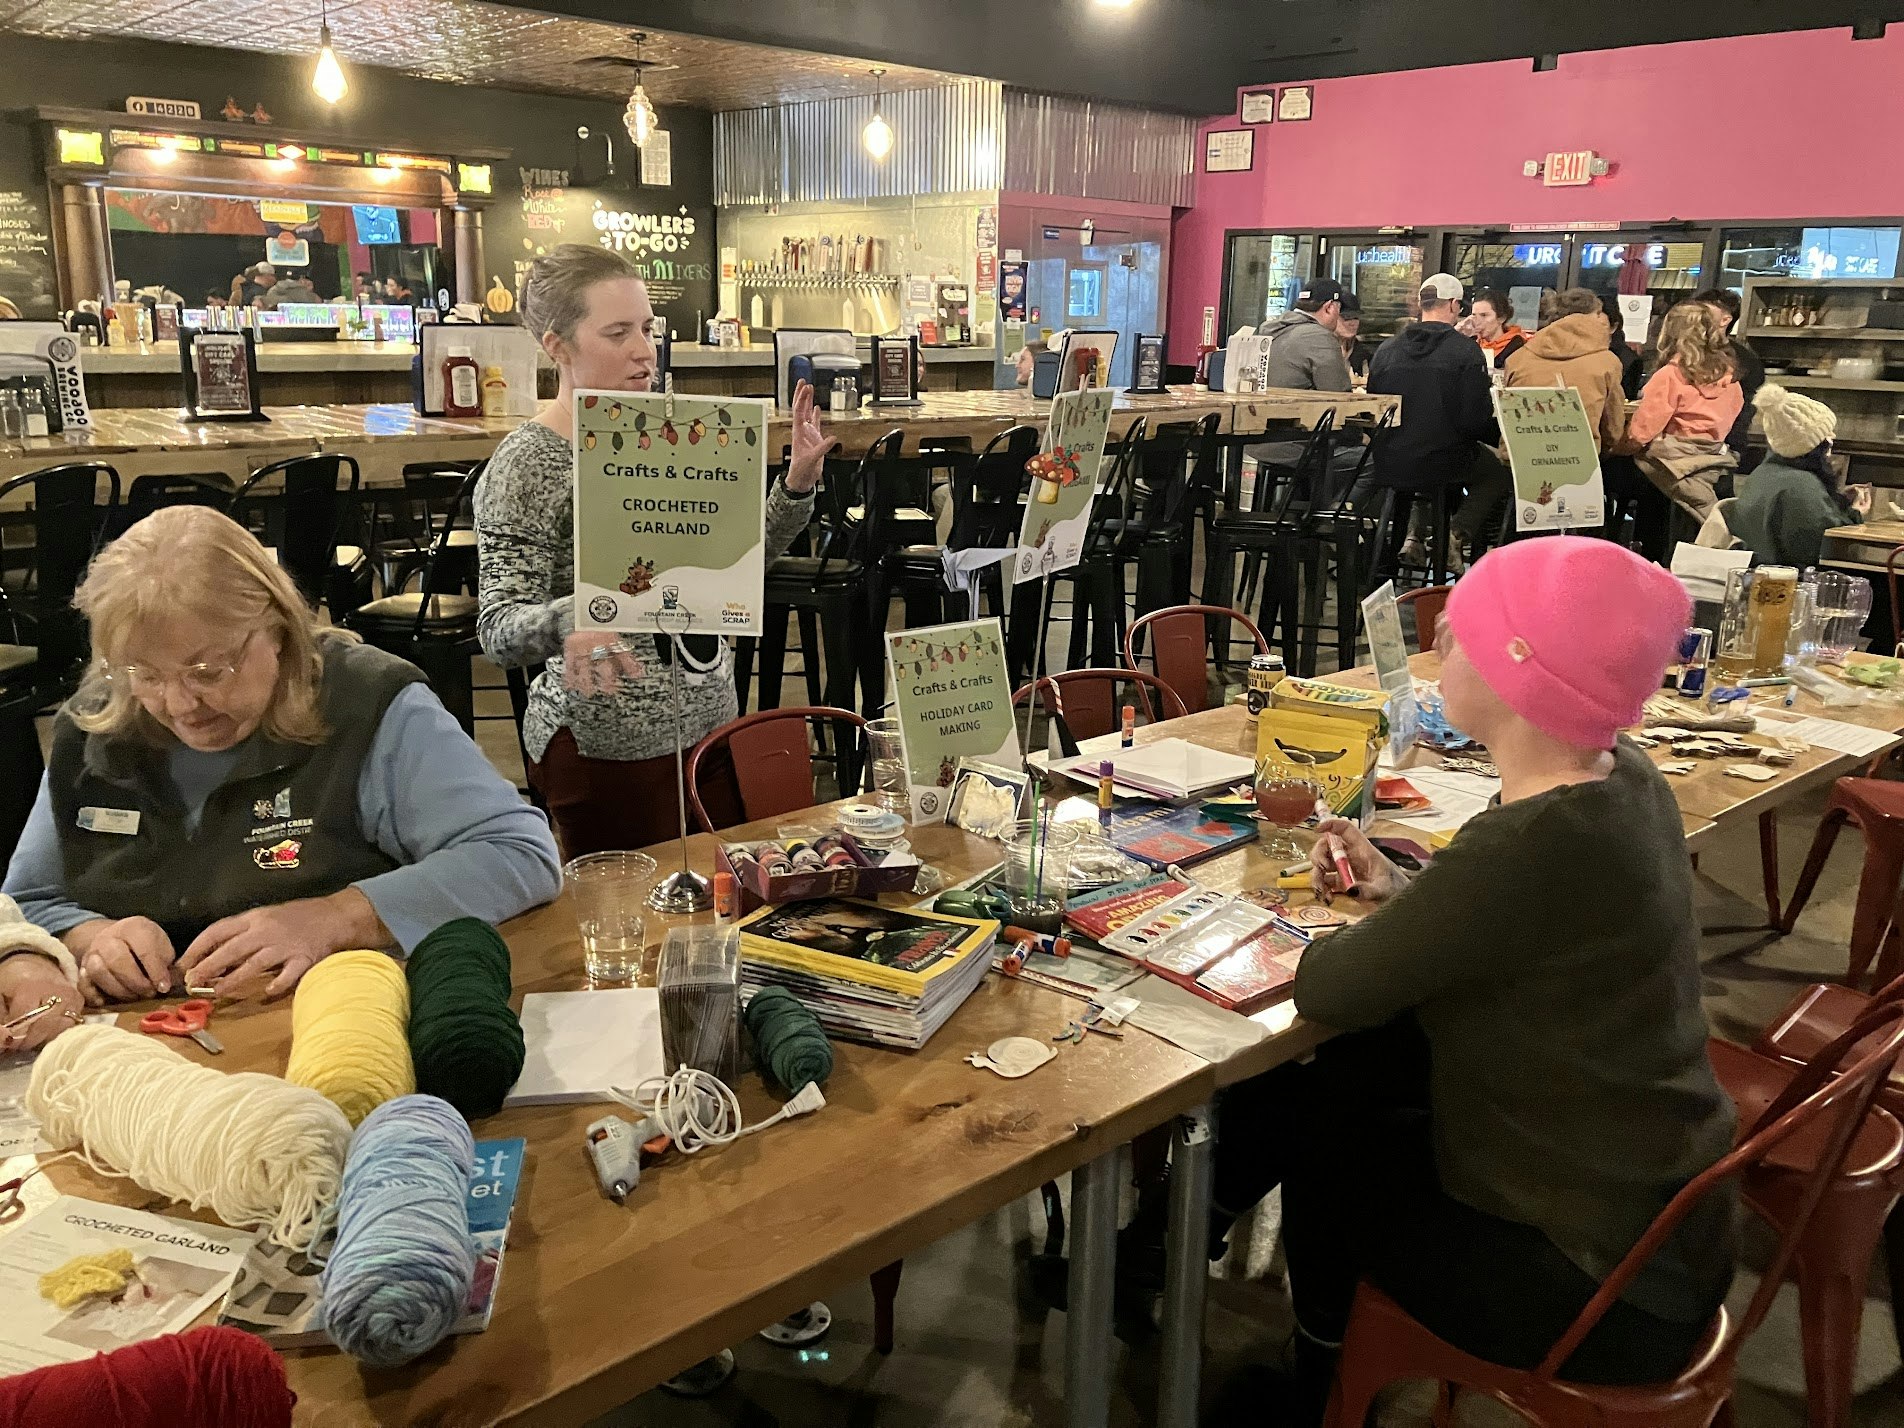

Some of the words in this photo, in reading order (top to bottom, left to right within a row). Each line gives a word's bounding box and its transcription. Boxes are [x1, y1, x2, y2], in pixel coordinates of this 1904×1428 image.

[519, 166, 569, 187] WINES
[1551, 152, 1587, 181] EXIT
[592, 209, 696, 235] GROWLERS
[611, 231, 679, 253] TO-GO
[652, 259, 712, 281] MIXERS
[1515, 424, 1543, 434] Crafts
[1552, 424, 1579, 433] Crafts
[602, 462, 660, 479] Crafts
[664, 465, 678, 479] &
[683, 465, 739, 482] Crafts
[1531, 457, 1580, 466] ORNAMENTS
[622, 498, 719, 514] CROCHETED
[631, 521, 711, 536] GARLAND
[722, 609, 744, 617] Gives
[722, 616, 750, 624] SCRAP
[912, 681, 948, 697] Crafts
[950, 680, 958, 690] &
[960, 674, 994, 688] Crafts
[920, 706, 966, 722] HOLIDAY
[968, 700, 994, 713] CARD
[939, 719, 981, 737] MAKING
[1108, 895, 1170, 919] AMAZING
[470, 1150, 510, 1179] st
[64, 1214, 154, 1240] CROCHETED
[155, 1233, 231, 1256] GARLAND
